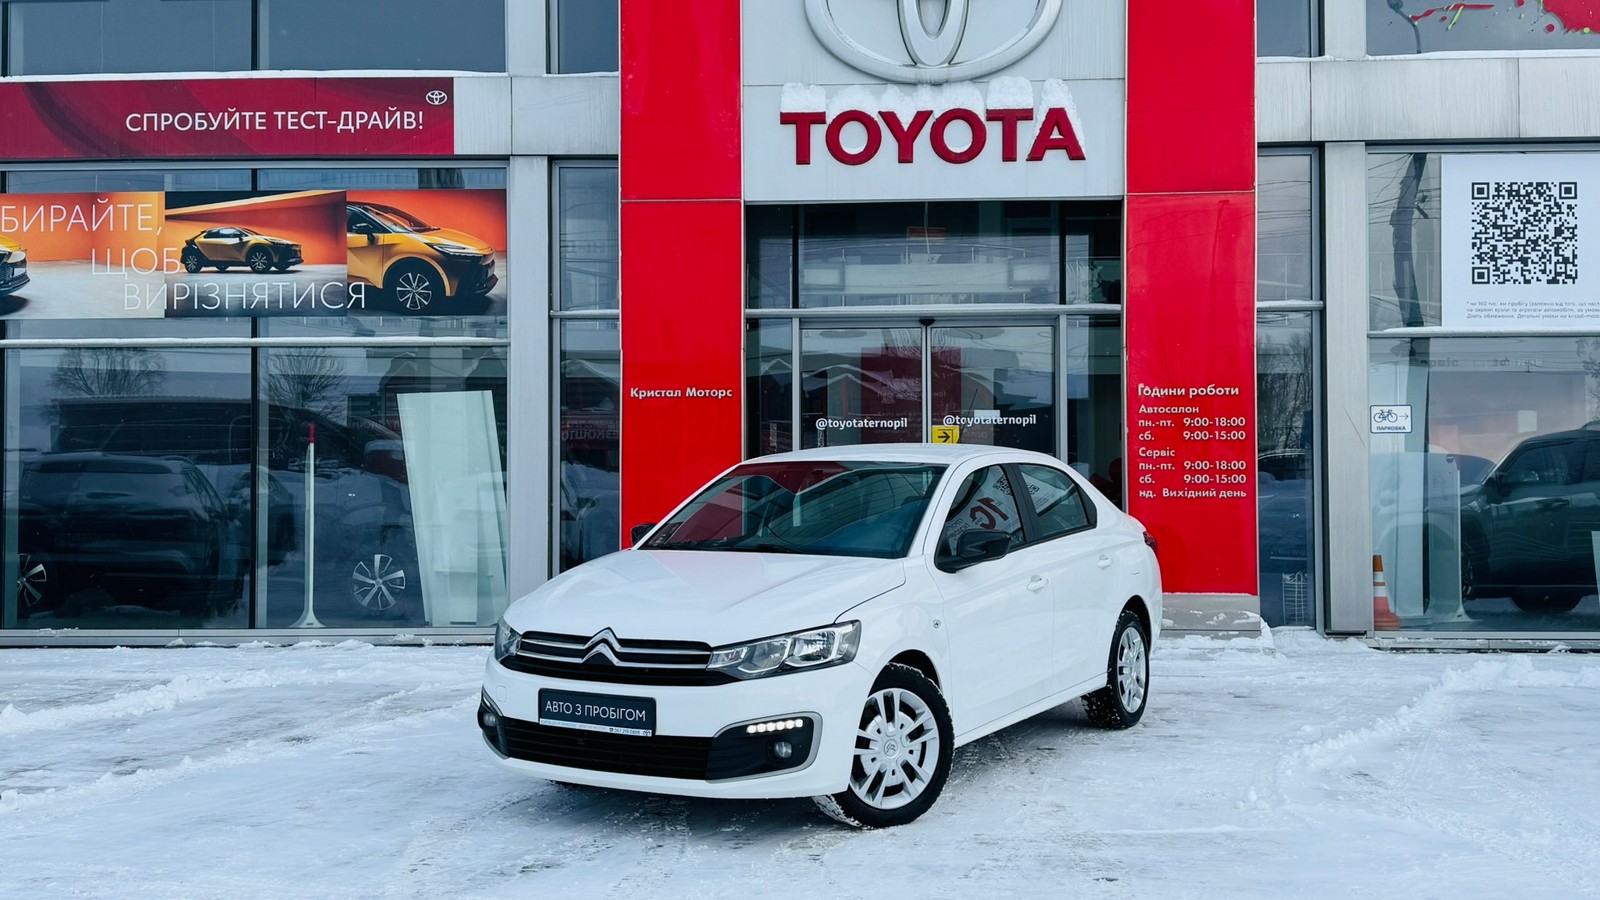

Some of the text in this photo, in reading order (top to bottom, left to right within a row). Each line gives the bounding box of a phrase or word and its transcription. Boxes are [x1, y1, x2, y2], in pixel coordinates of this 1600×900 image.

[125, 105, 424, 133] СПРОБУЙТЕ ТЕСТ-ДРАЙВ!
[780, 107, 1086, 166] TOYOTA
[1, 198, 163, 234] БИРАЙТЕ,
[91, 247, 181, 278] ЩОБ
[124, 282, 366, 311] ВИРІЗНЯТИСЯ
[630, 387, 733, 399] Кристал Моторс
[1137, 384, 1239, 398] Години роботи
[1138, 404, 1199, 414] Автосалон
[815, 417, 908, 431] @toyotaternopil
[943, 414, 1037, 428] @toyotaternopil
[1138, 417, 1246, 427] пн.-пт. 9:00-18:00
[1138, 431, 1246, 441] сб. 9:00-15:00
[1138, 447, 1176, 459] Сервіс
[1138, 460, 1247, 470] пн.-пт. 9:00-18:00
[1139, 474, 1247, 484] сб. 9:00-15:00
[1139, 487, 1247, 498] нд. Вихідний день
[545, 700, 573, 714] АВТО
[584, 705, 646, 721] ПРОБІГОМ
